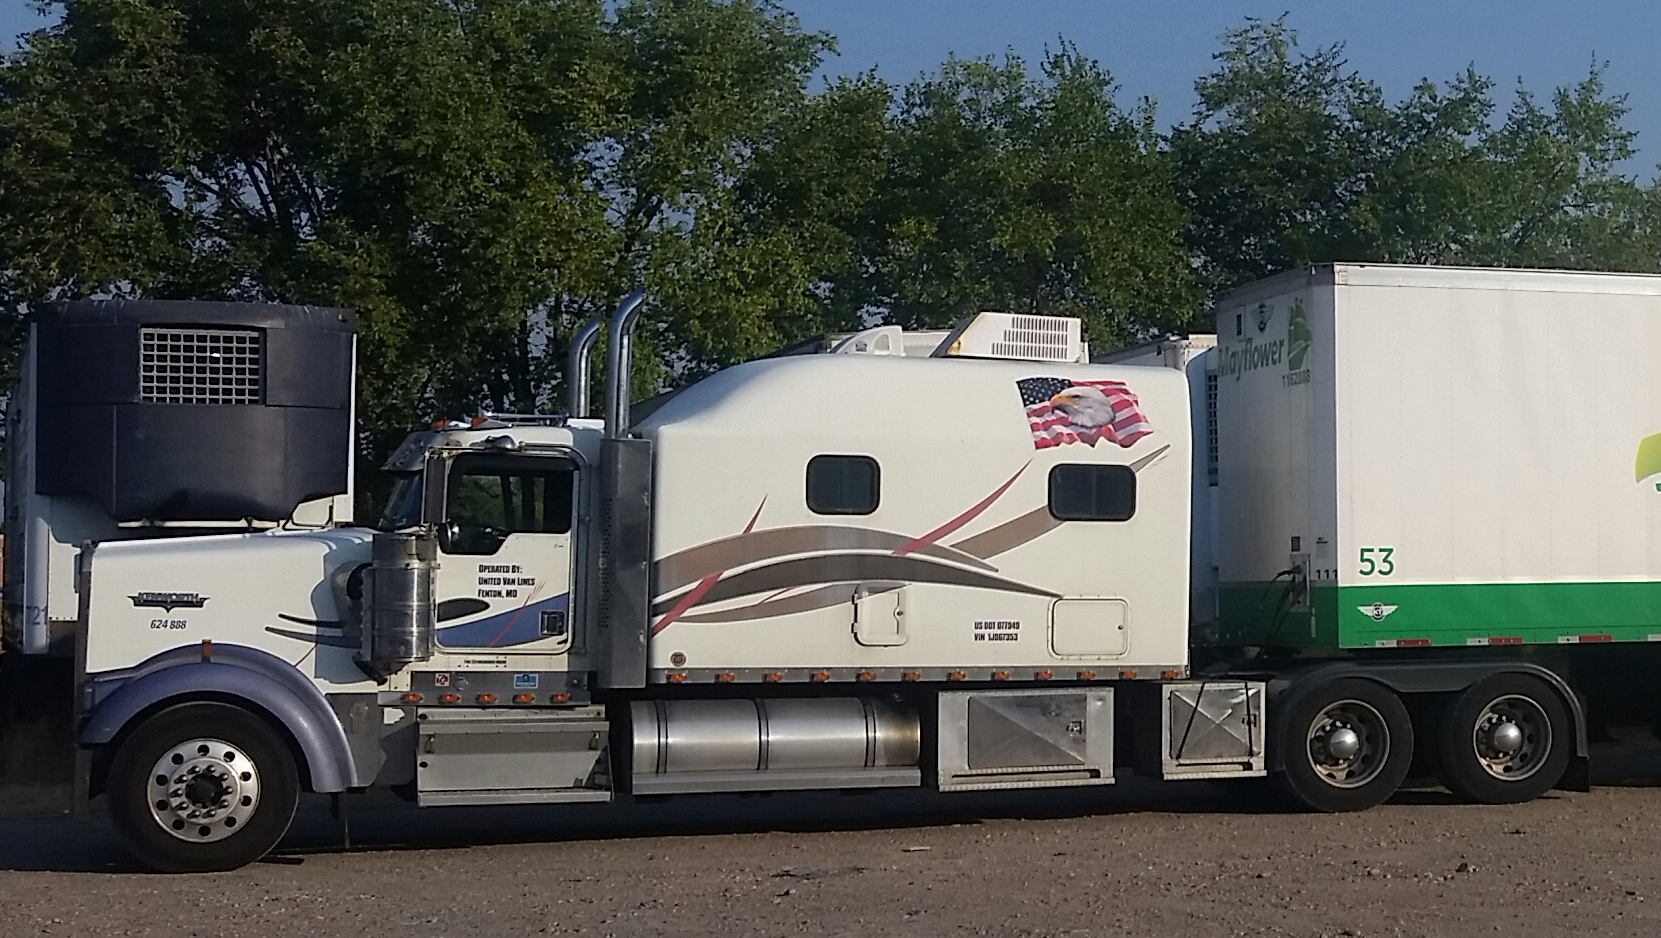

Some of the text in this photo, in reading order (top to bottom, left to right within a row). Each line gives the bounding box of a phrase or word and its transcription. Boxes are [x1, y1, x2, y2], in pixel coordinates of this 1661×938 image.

[1218, 338, 1285, 383] Mayflower
[1359, 547, 1395, 576] 53
[478, 564, 523, 574] OPERATED BY:
[478, 576, 536, 586] UNITED VAN LINES
[478, 589, 518, 598] FENTON, MO
[150, 619, 188, 630] 624 888
[974, 621, 983, 630] US
[984, 621, 996, 630] DOT
[974, 633, 986, 641] VIN
